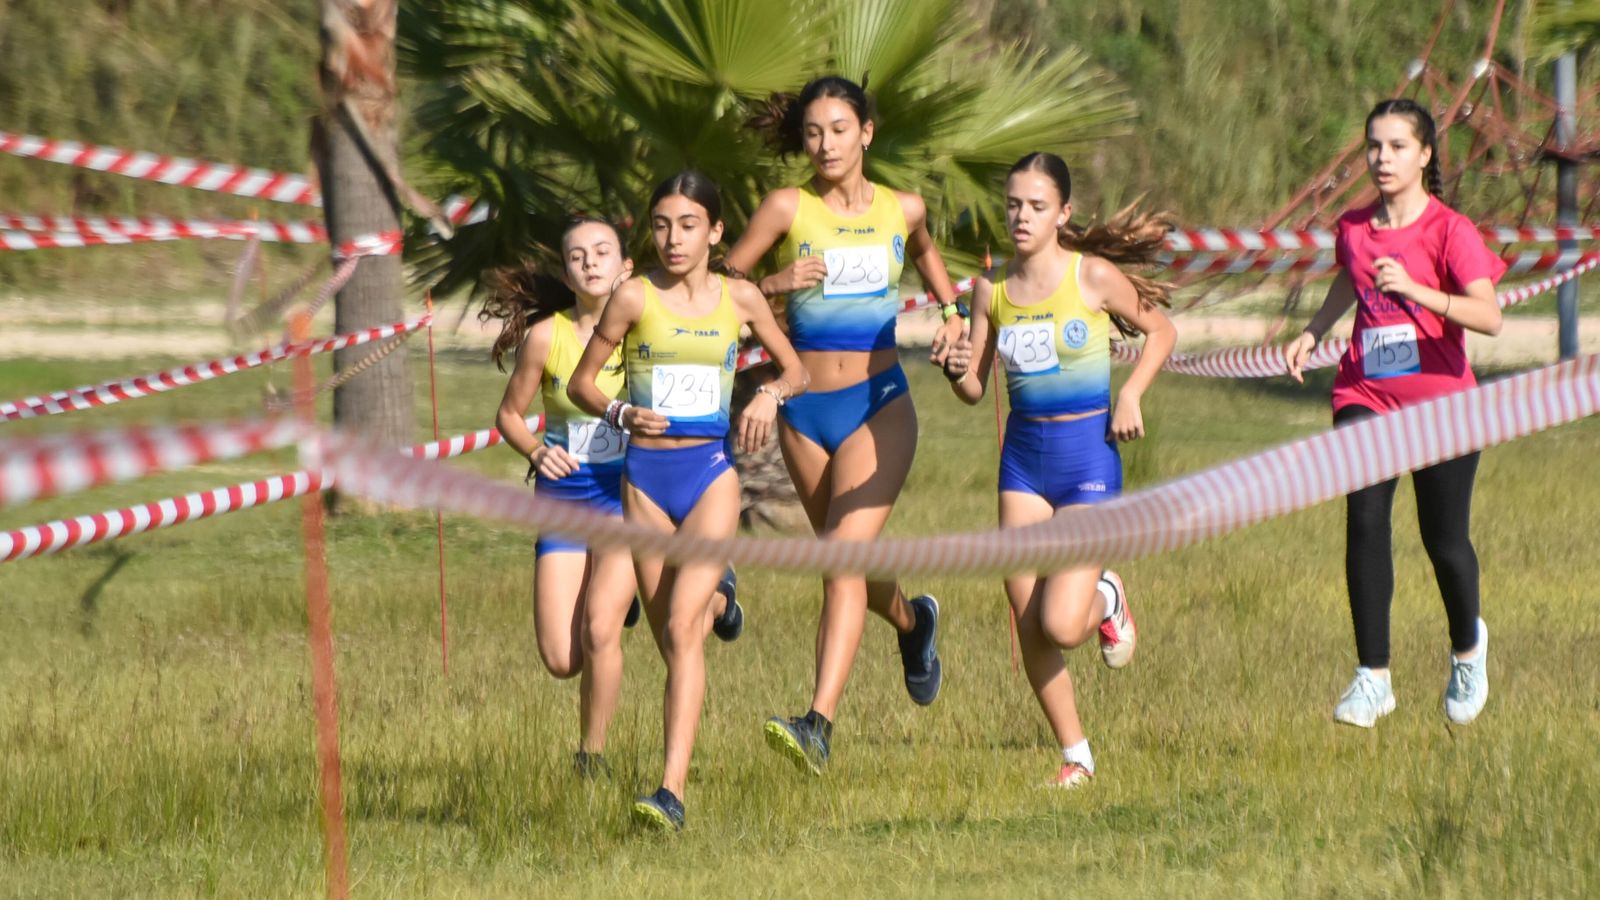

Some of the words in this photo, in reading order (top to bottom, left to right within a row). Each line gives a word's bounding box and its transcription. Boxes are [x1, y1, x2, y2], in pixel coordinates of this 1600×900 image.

[1004, 329, 1052, 366] 233
[1371, 331, 1412, 368] 153
[658, 372, 714, 408] 234
